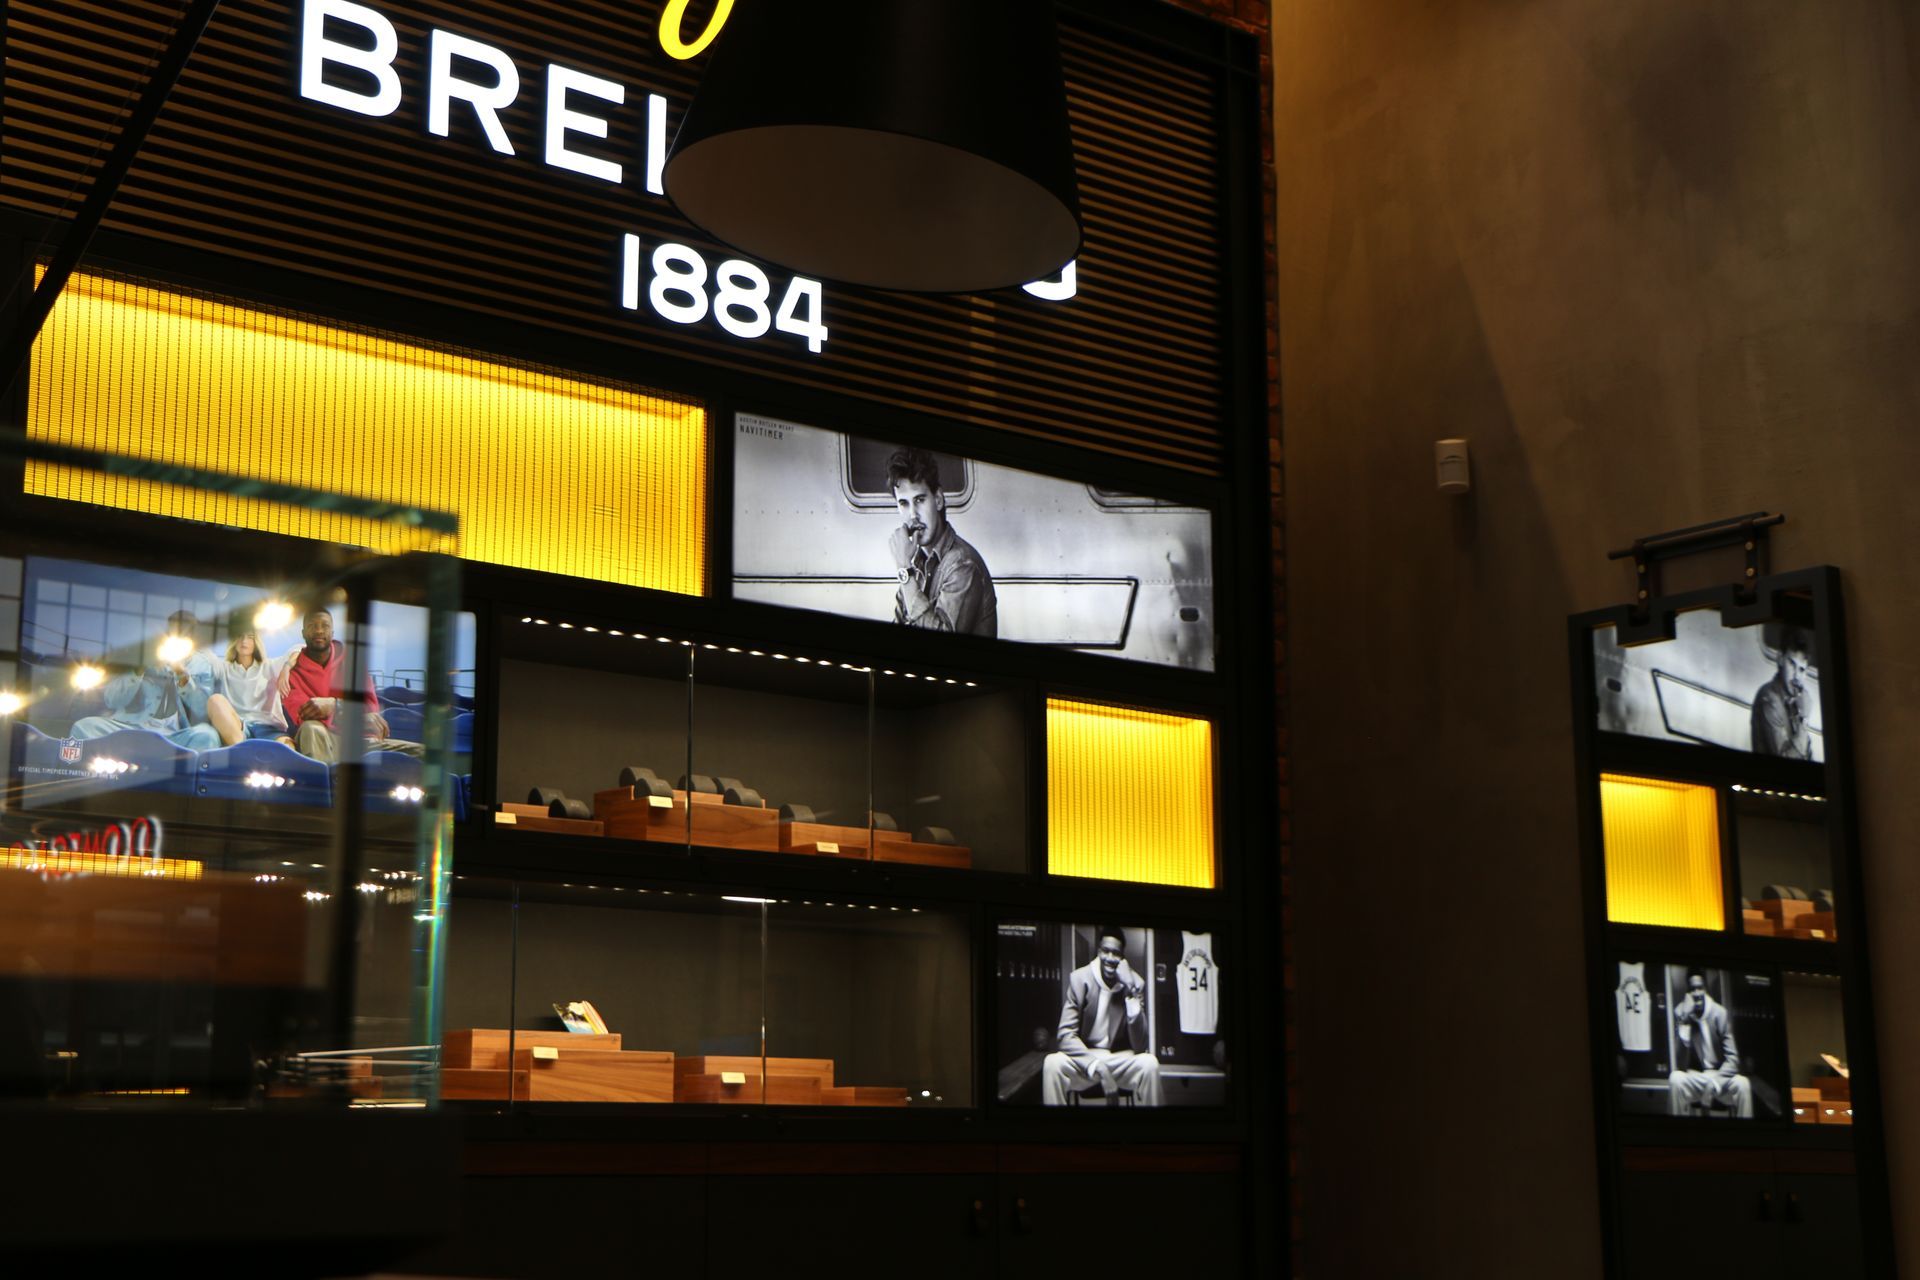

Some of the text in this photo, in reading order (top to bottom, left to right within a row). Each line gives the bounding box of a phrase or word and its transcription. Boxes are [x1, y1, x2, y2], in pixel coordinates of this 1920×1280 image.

[621, 232, 829, 354] 1884
[740, 425, 783, 440] NAVITIMER
[63, 748, 79, 759] NFL
[18, 766, 41, 774] OFFICIAL
[42, 767, 68, 776] TIMEPIECE
[69, 769, 91, 777] PARTNER
[1189, 967, 1208, 991] 34
